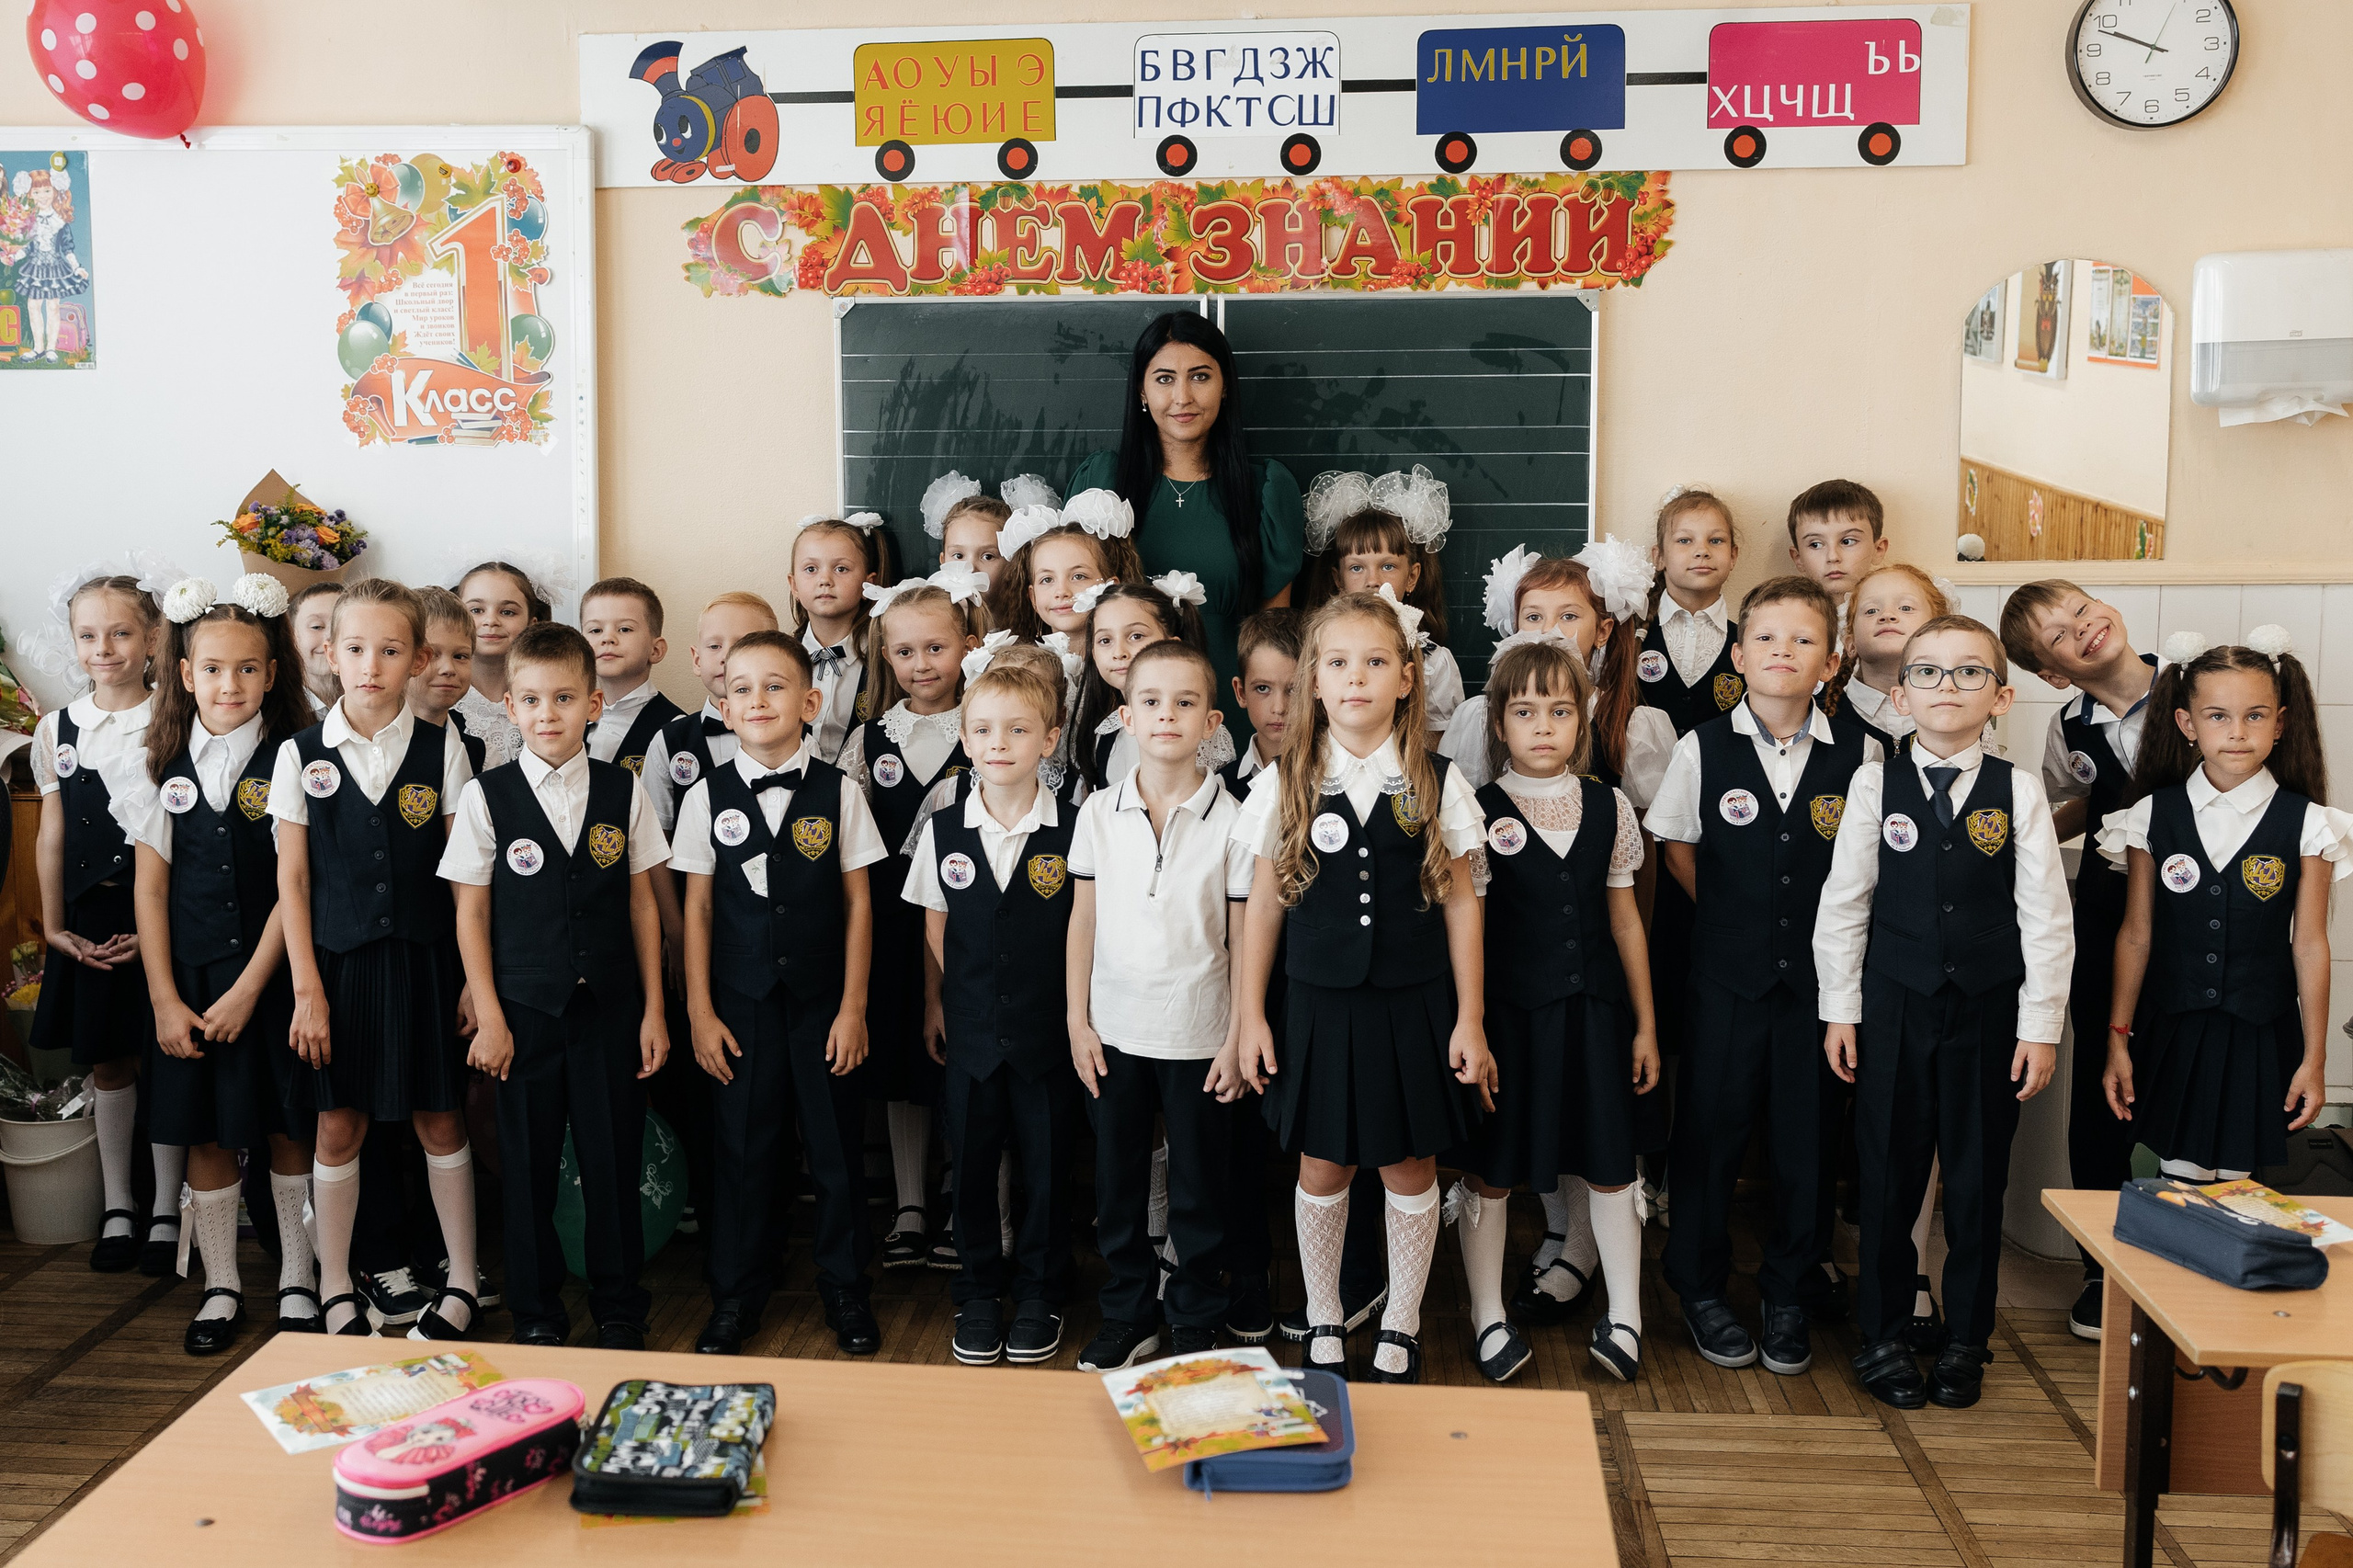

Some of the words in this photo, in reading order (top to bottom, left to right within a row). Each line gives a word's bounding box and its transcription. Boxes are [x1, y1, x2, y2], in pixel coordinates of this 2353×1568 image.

[2093, 14, 2118, 28] 10
[2196, 8, 2211, 23] 2
[2086, 43, 2102, 58] 9
[2204, 36, 2220, 51] 3
[1139, 46, 1336, 87] БВГДЗЖ
[1427, 33, 1588, 83] ЛМНРЙ
[2095, 71, 2111, 85] 8
[2194, 66, 2211, 80] 4
[1710, 83, 1855, 122] ХЦЧЩ
[2116, 91, 2131, 107] 7
[2174, 87, 2190, 102] 5
[1138, 93, 1336, 129] ПФКТСШ
[2144, 99, 2160, 114] 6
[711, 200, 784, 284] С
[1189, 180, 1640, 286] ЗНАНИЙ
[410, 290, 438, 298] первый
[427, 195, 514, 383] 1
[429, 314, 455, 323] уроков
[390, 369, 517, 426] Класс
[1720, 679, 1736, 699] 42
[244, 782, 268, 805] 42
[404, 790, 426, 812] 42
[1818, 803, 1839, 825] 42
[797, 821, 819, 845] 42
[1977, 815, 1999, 838] 42
[598, 829, 620, 851] 42
[1033, 860, 1054, 883] 42
[2254, 861, 2275, 884] 42
